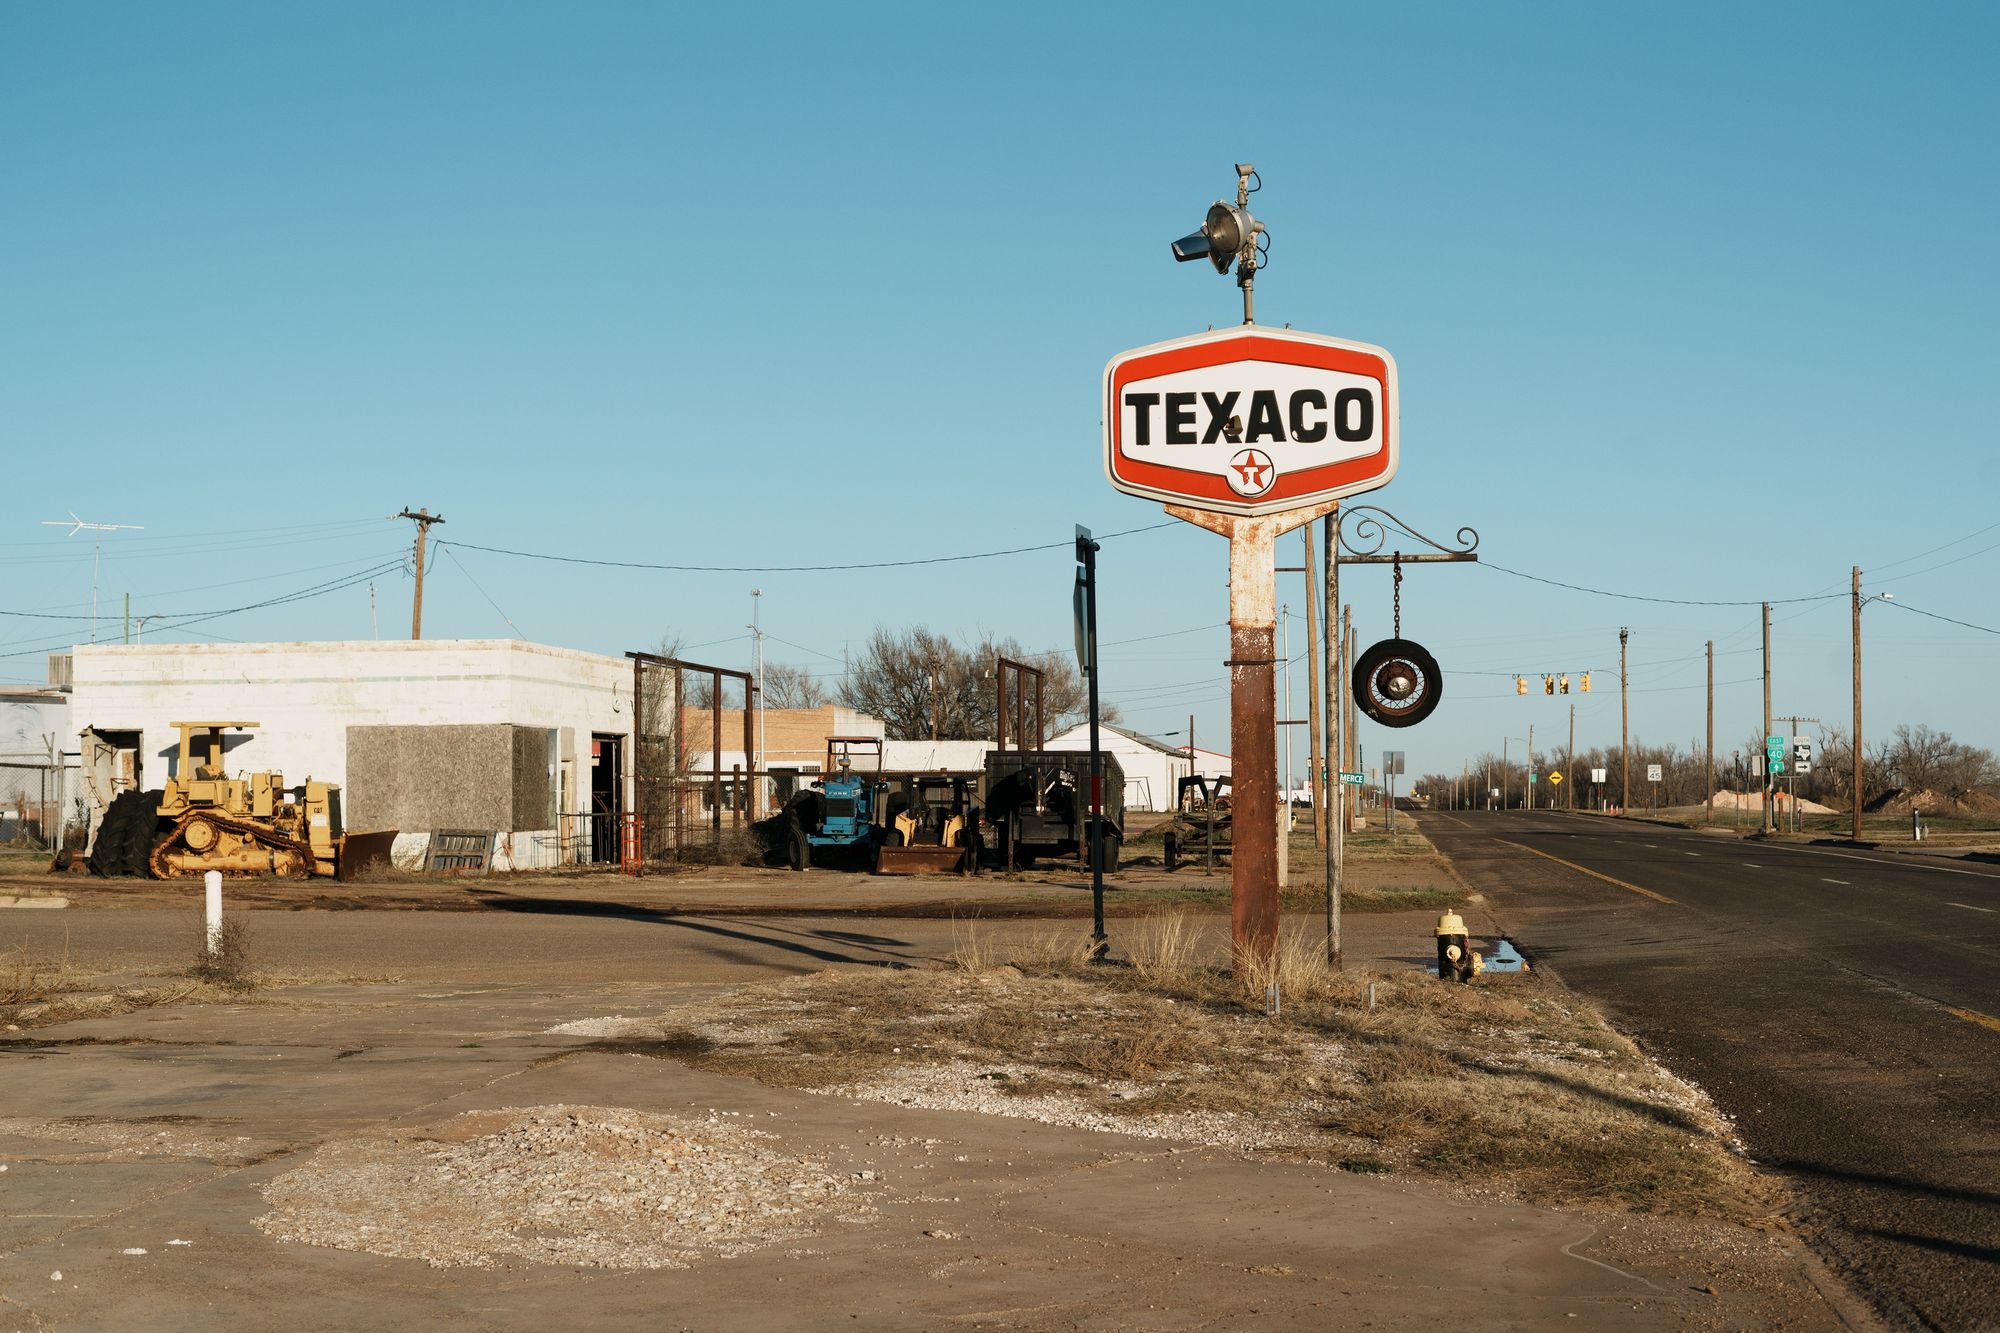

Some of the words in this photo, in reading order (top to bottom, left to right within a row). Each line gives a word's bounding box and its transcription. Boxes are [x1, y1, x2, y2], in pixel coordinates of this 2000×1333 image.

[1125, 387, 1374, 446] TEXACO
[1243, 466, 1259, 485] T
[1770, 750, 1782, 759] 40
